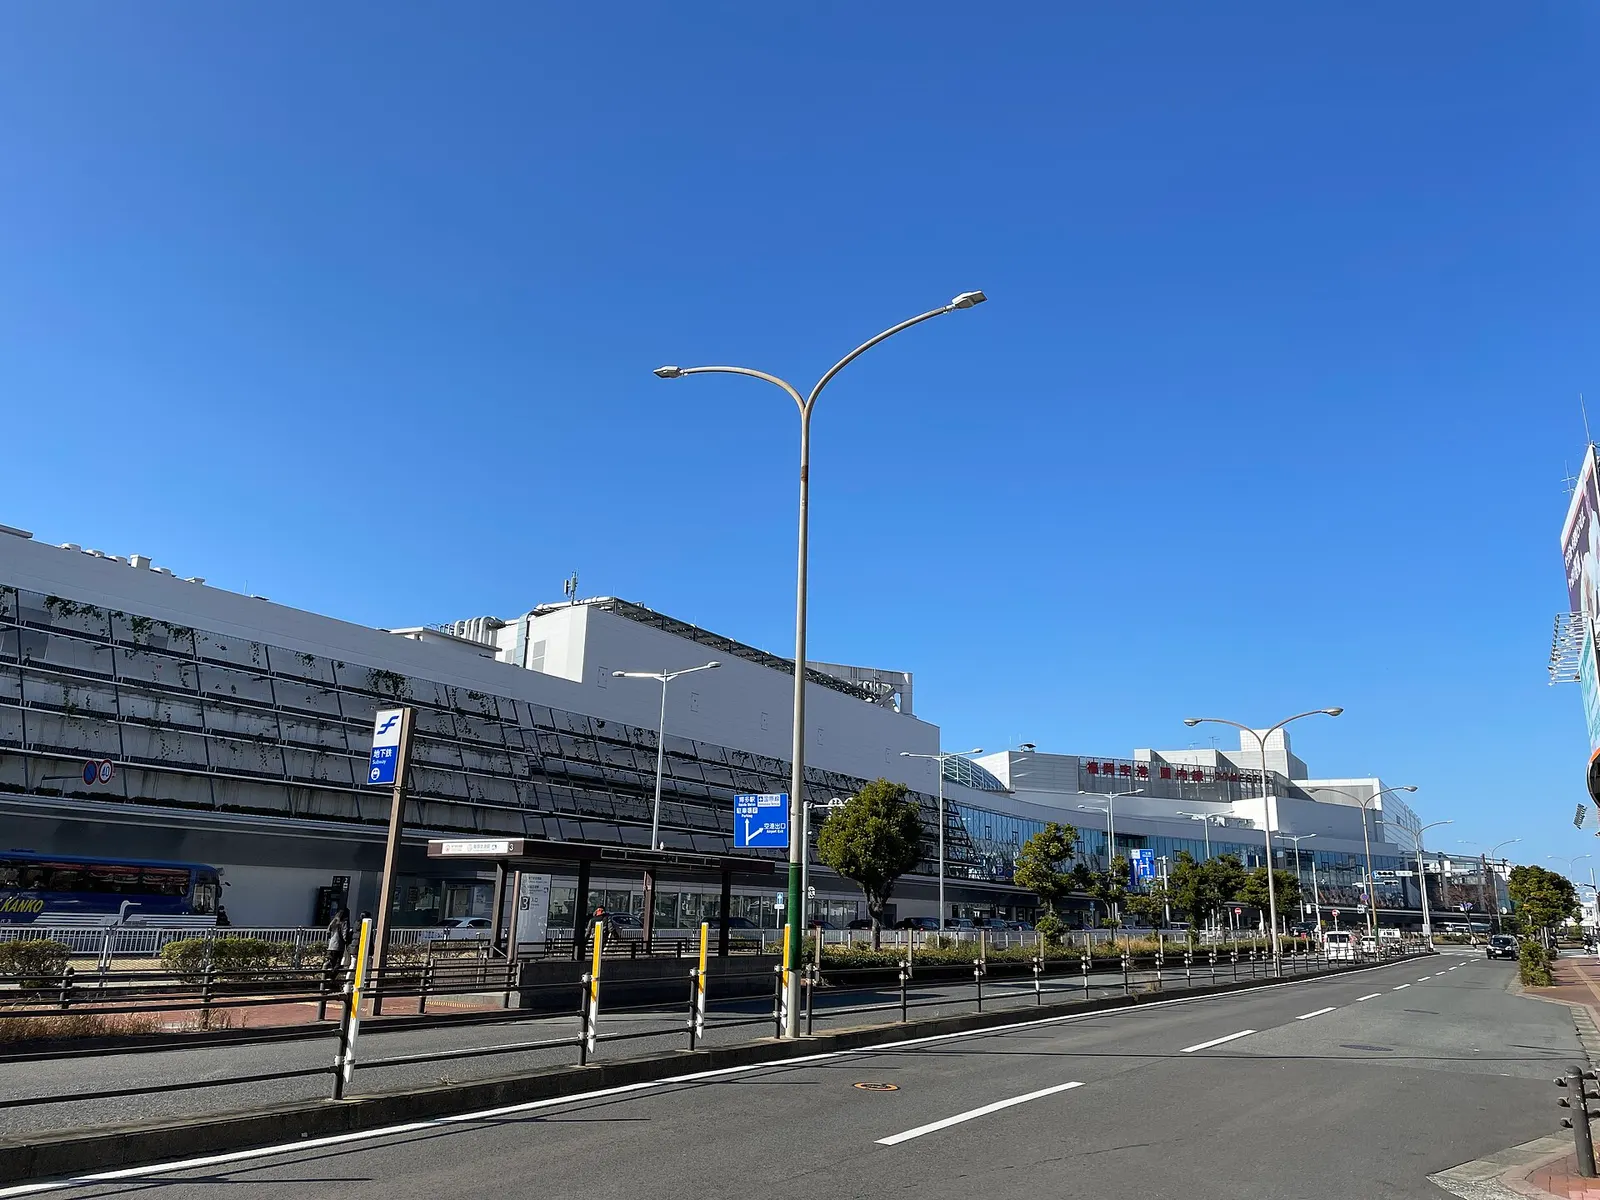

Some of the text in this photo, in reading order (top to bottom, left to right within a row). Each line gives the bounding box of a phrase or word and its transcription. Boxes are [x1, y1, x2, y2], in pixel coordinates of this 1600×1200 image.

[373, 748, 393, 759] 地下鉄
[101, 766, 110, 778] 40
[508, 843, 514, 852] 3
[0, 896, 44, 914] KANKO
[521, 897, 530, 910] 3
